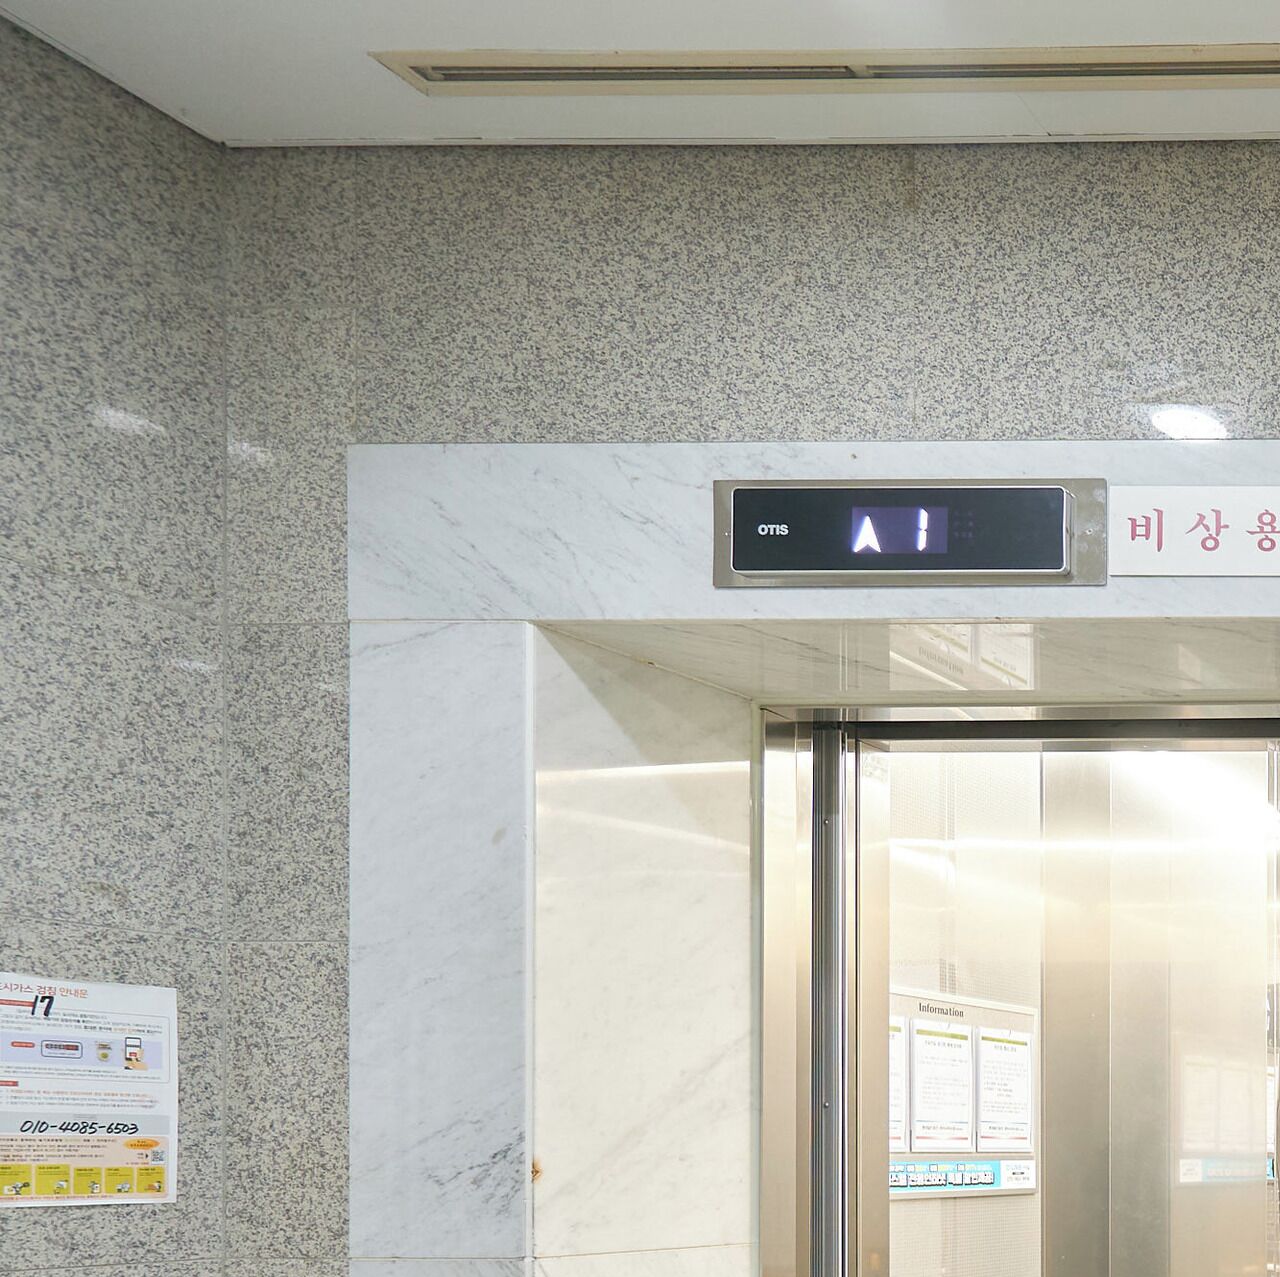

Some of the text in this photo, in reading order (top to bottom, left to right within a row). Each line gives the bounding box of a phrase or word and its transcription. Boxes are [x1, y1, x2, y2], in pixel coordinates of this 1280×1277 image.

[758, 524, 789, 535] OTIS
[917, 508, 928, 552] 1
[60, 987, 88, 999] 안내문
[31, 995, 54, 1017] 17
[919, 1003, 964, 1018] Information
[20, 1120, 139, 1135] 010-4085-6503
